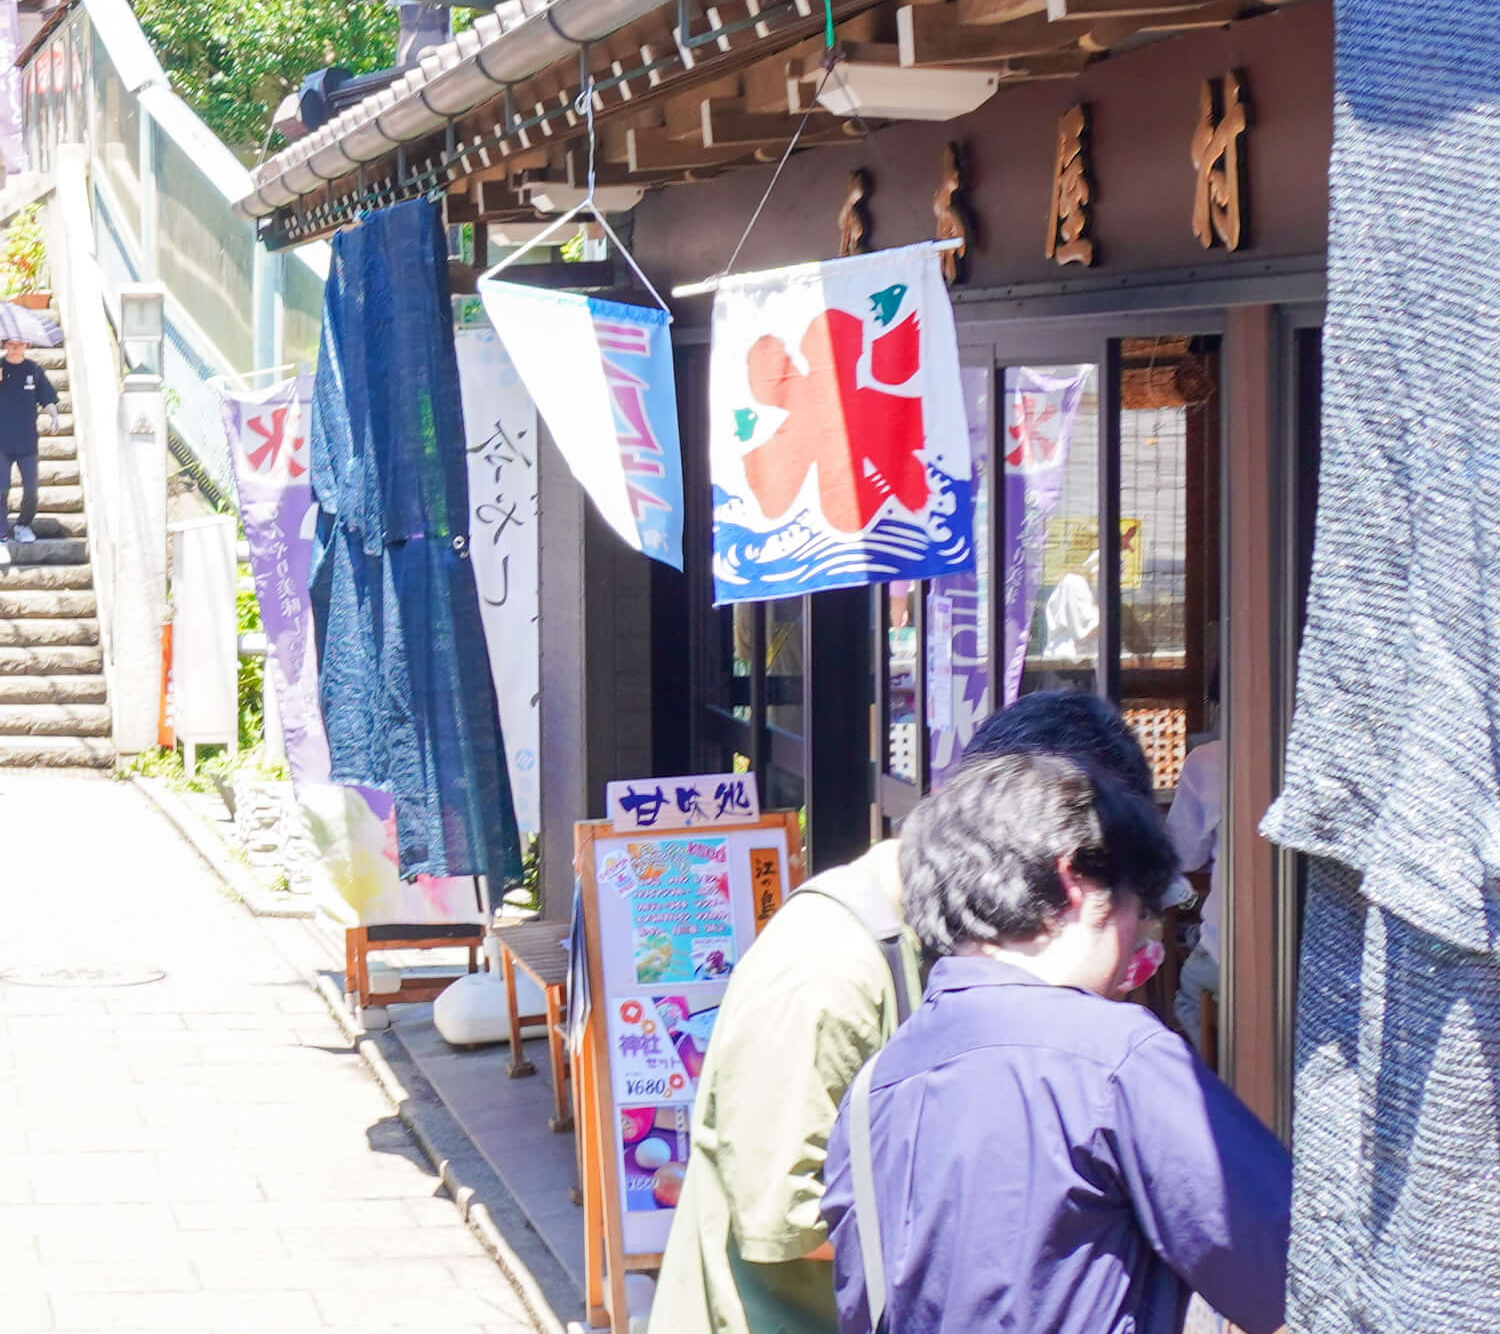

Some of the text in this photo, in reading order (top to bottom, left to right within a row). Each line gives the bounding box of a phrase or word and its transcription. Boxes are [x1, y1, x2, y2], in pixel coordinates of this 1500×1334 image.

[743, 305, 930, 534] 氷
[755, 859, 777, 921] 江の島
[618, 1033, 662, 1056] 神社
[626, 1078, 667, 1096] ¥680
